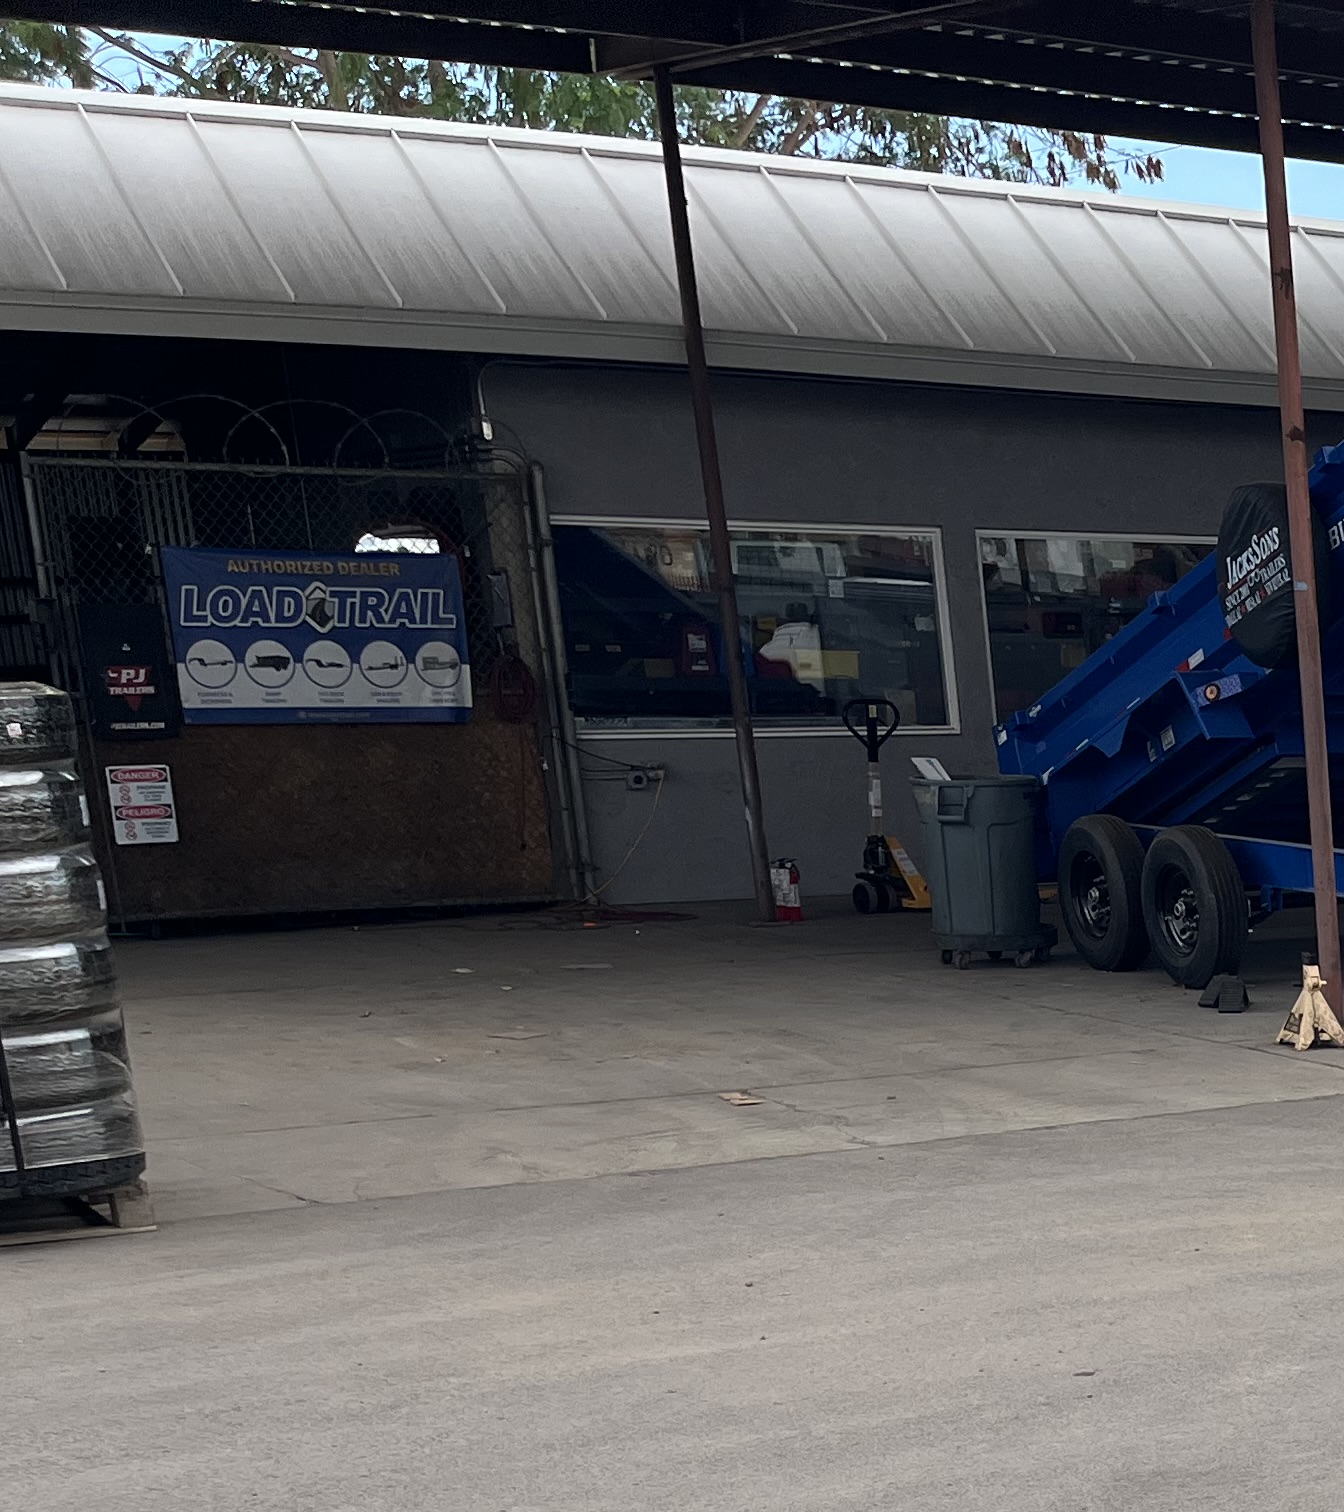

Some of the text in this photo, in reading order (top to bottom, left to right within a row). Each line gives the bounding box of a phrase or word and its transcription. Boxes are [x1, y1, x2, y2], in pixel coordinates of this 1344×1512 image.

[227, 560, 401, 575] AUTHORIZED DEALER
[180, 585, 457, 629] LOAD TRAIL
[120, 668, 146, 683] PJ
[108, 686, 155, 695] TRAILERS
[117, 772, 160, 780] DANGER
[121, 808, 166, 816] PELIGRO
